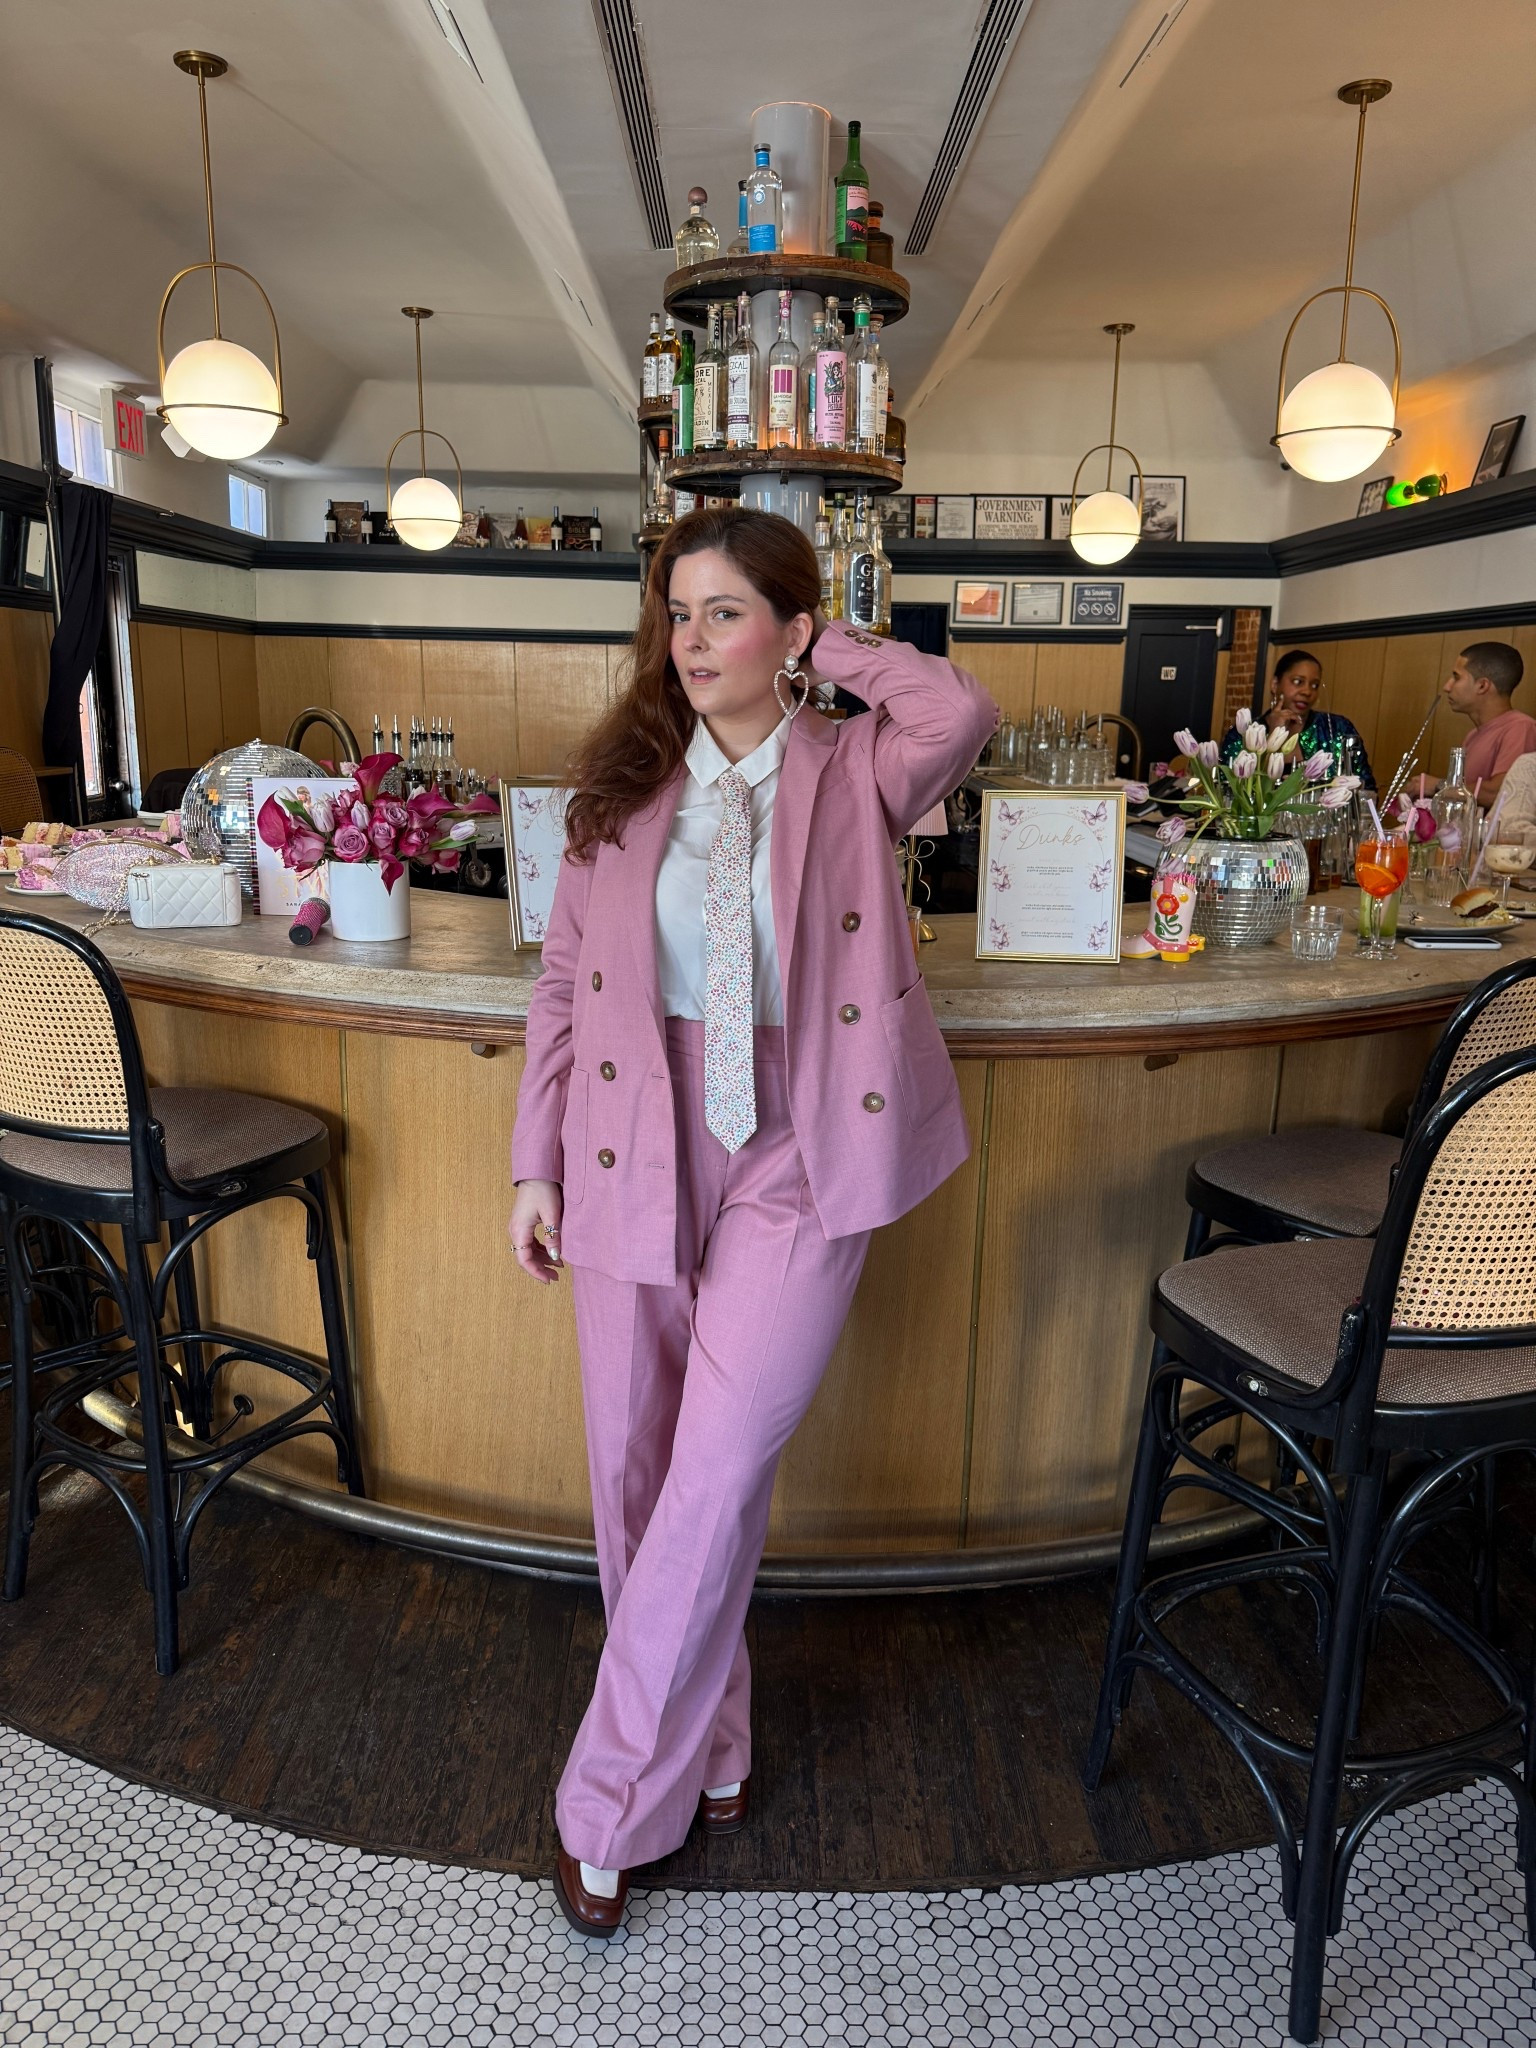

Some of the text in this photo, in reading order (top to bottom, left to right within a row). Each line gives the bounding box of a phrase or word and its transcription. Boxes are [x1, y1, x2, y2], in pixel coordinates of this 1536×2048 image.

[730, 361, 748, 370] EZCAL
[695, 368, 711, 377] DRE
[117, 401, 145, 456] EXIT
[976, 499, 1043, 512] GOVERNMENT
[984, 511, 1033, 523] WARNING:
[1017, 824, 1086, 850] Drinks
